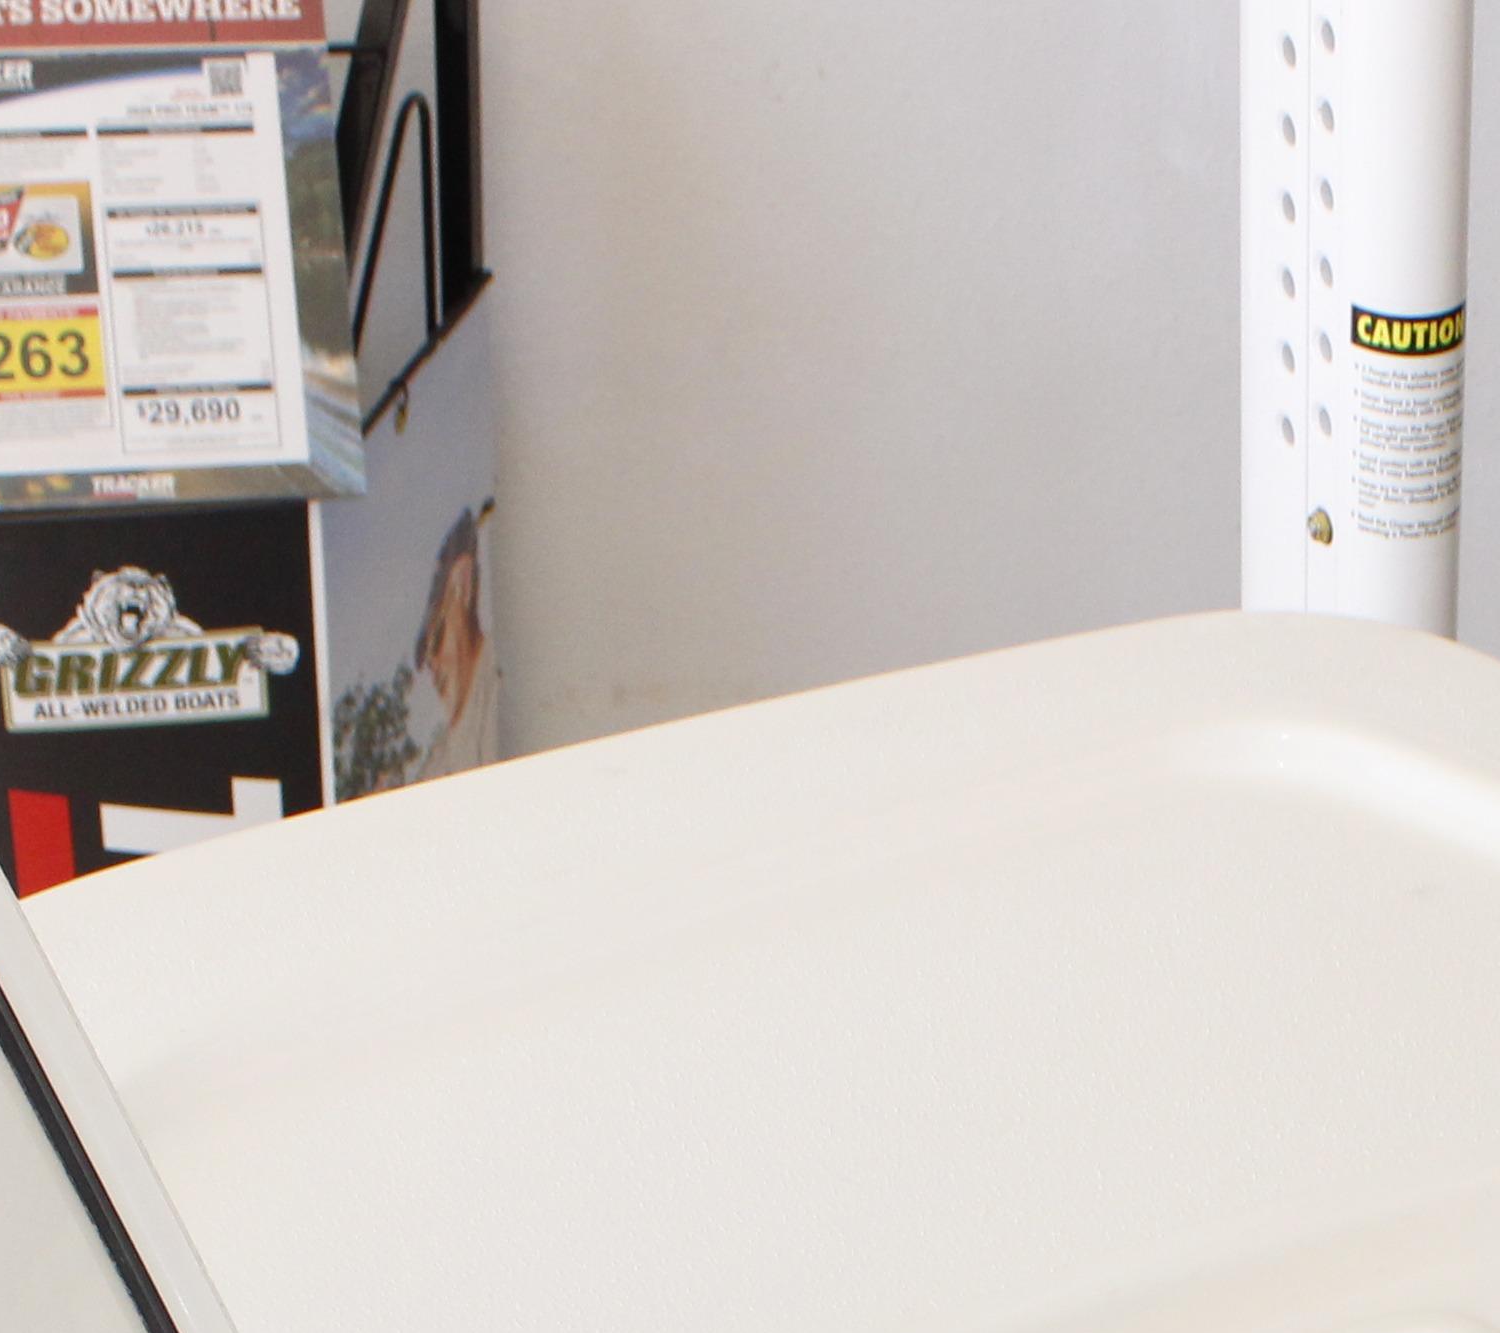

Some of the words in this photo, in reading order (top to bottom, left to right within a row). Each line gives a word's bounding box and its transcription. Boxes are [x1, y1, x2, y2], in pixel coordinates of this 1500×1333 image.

[41, 0, 301, 25] SOMEWHERE
[1357, 308, 1465, 351] CAUTION
[137, 397, 241, 426] $29,690
[13, 641, 249, 699] GRIZZLY
[33, 695, 168, 720] ALL-WELDED
[173, 690, 241, 712] BOATS
